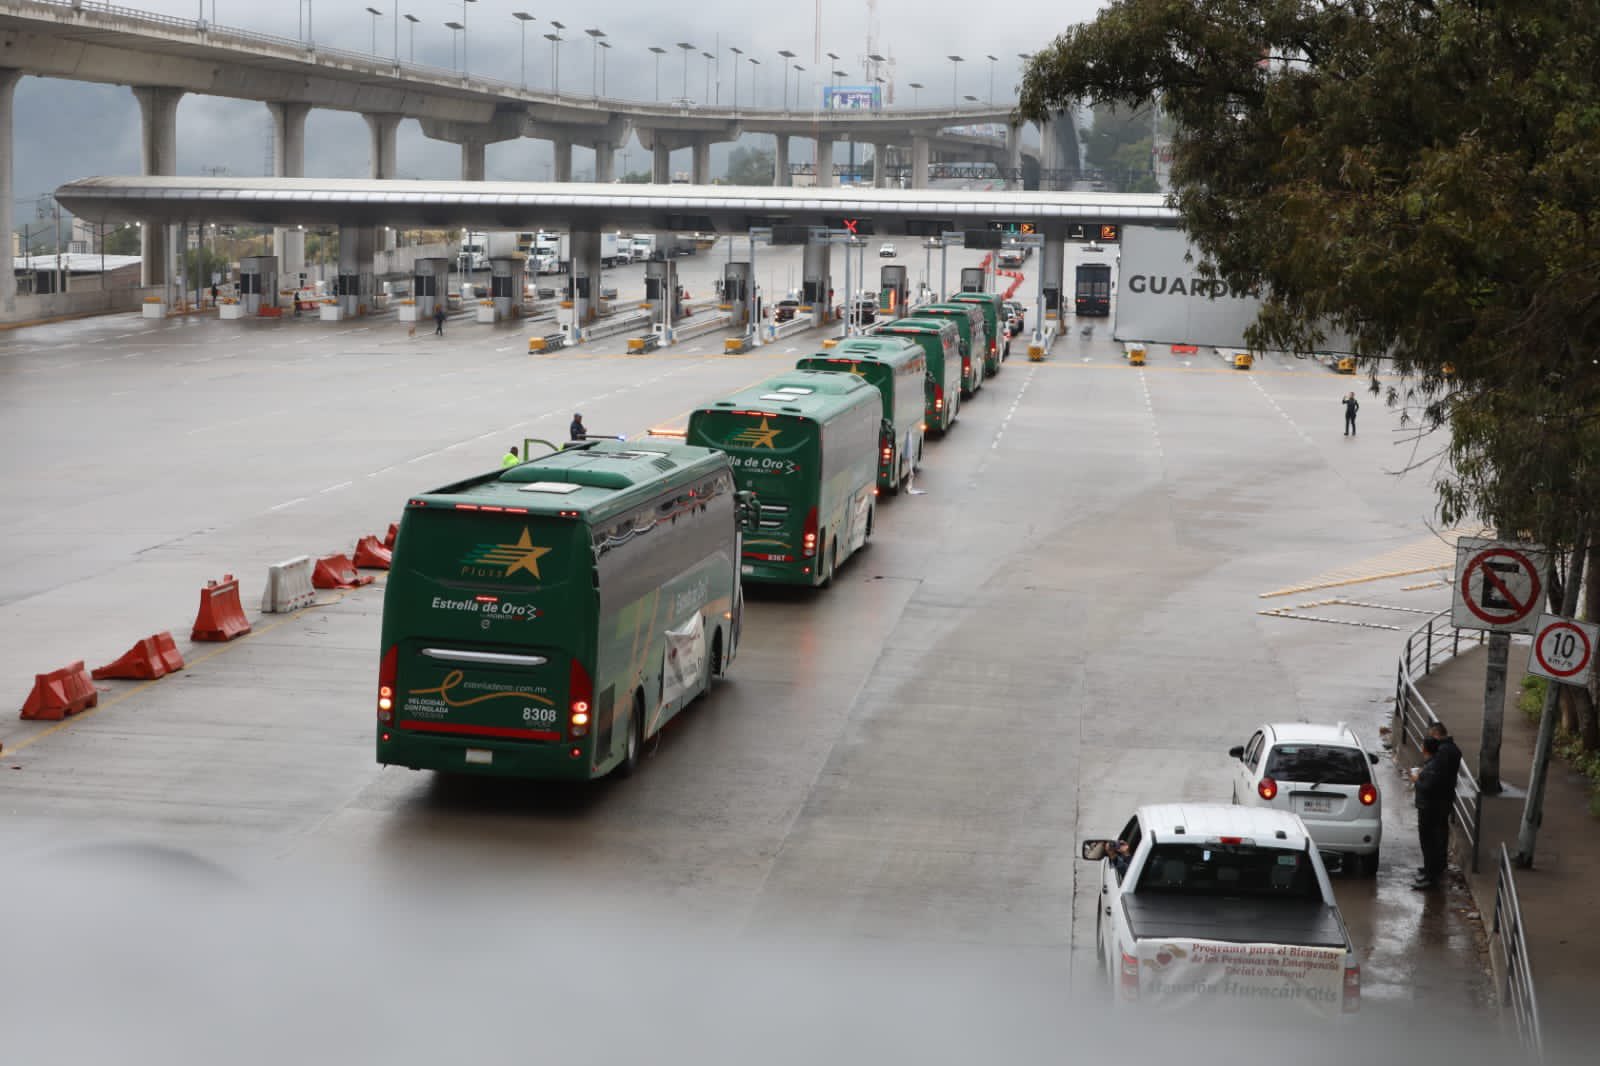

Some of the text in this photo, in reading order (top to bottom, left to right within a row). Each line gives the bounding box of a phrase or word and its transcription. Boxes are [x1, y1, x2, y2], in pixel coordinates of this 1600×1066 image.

[744, 457, 759, 468] de
[762, 458, 783, 469] Oro
[432, 597, 526, 615] Estrella de Oro
[1554, 632, 1575, 659] 10
[403, 704, 449, 713] CONTROLADA
[523, 707, 557, 722] 8308
[1191, 953, 1202, 963] de
[1192, 943, 1339, 960] Programa para el Bienestar
